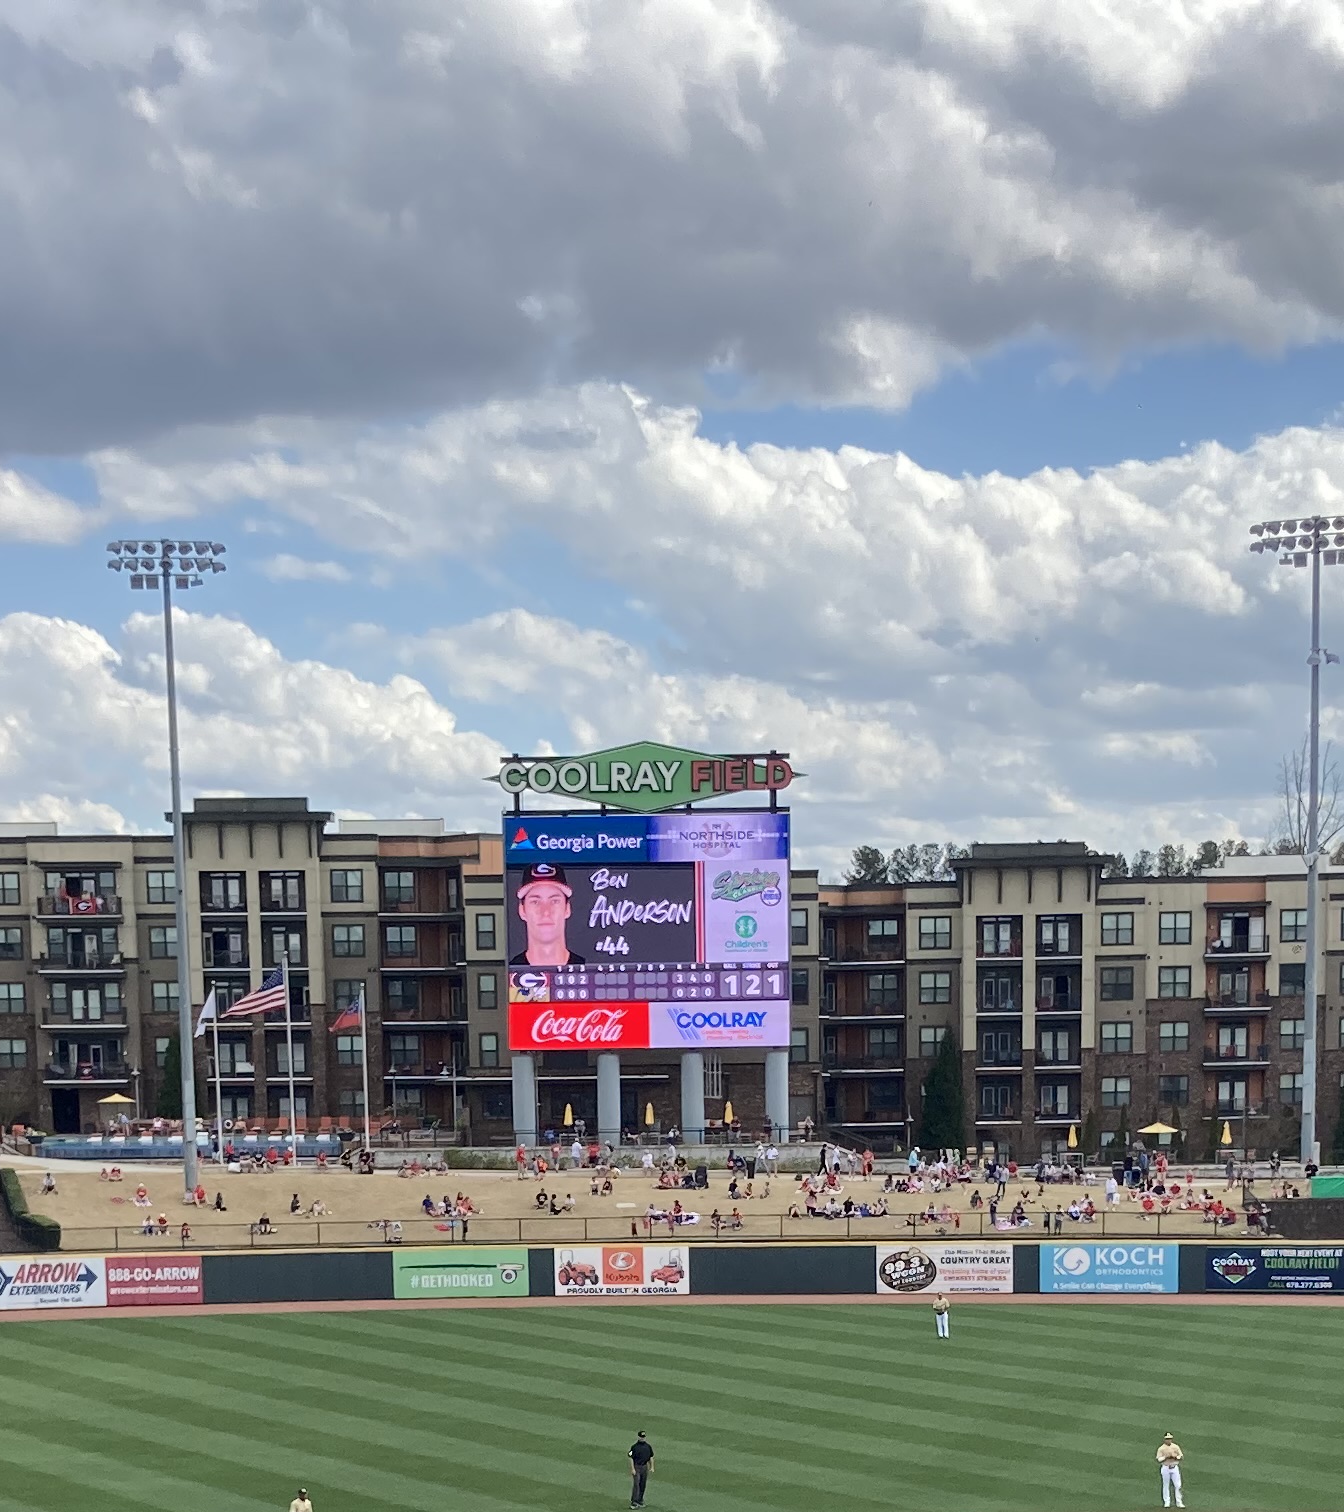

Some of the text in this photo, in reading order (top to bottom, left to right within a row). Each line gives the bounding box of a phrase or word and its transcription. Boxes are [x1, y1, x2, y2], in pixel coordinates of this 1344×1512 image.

[499, 759, 793, 794] COOLRAY FIELD
[679, 831, 754, 840] NORTHSIDE
[536, 834, 643, 852] Georgia Power
[595, 936, 629, 955] #44
[725, 940, 768, 949] Children's
[558, 974, 711, 984] 1 0 2 3 4 0
[724, 974, 780, 995] 1 2 1
[557, 988, 711, 999] 0 0 0 0 2 0
[531, 1008, 629, 1043] Coca-Cola
[676, 1012, 767, 1028] COOLRAY
[940, 1256, 1010, 1264] COUNTRY GREAT
[1096, 1247, 1164, 1266] KOCH
[1212, 1257, 1255, 1266] COOLRAY
[1264, 1258, 1307, 1269] COOLRAY
[13, 1263, 82, 1284] ARROW
[108, 1267, 199, 1281] 888-GO-ARROW
[1096, 1268, 1163, 1276] ORTHODONTICS
[410, 1274, 493, 1288] #GETHOOKED
[1060, 1282, 1080, 1290] Smile
[1081, 1282, 1095, 1290] Can
[1097, 1282, 1123, 1291] Change
[9, 1284, 81, 1296] EXTERMINATORS
